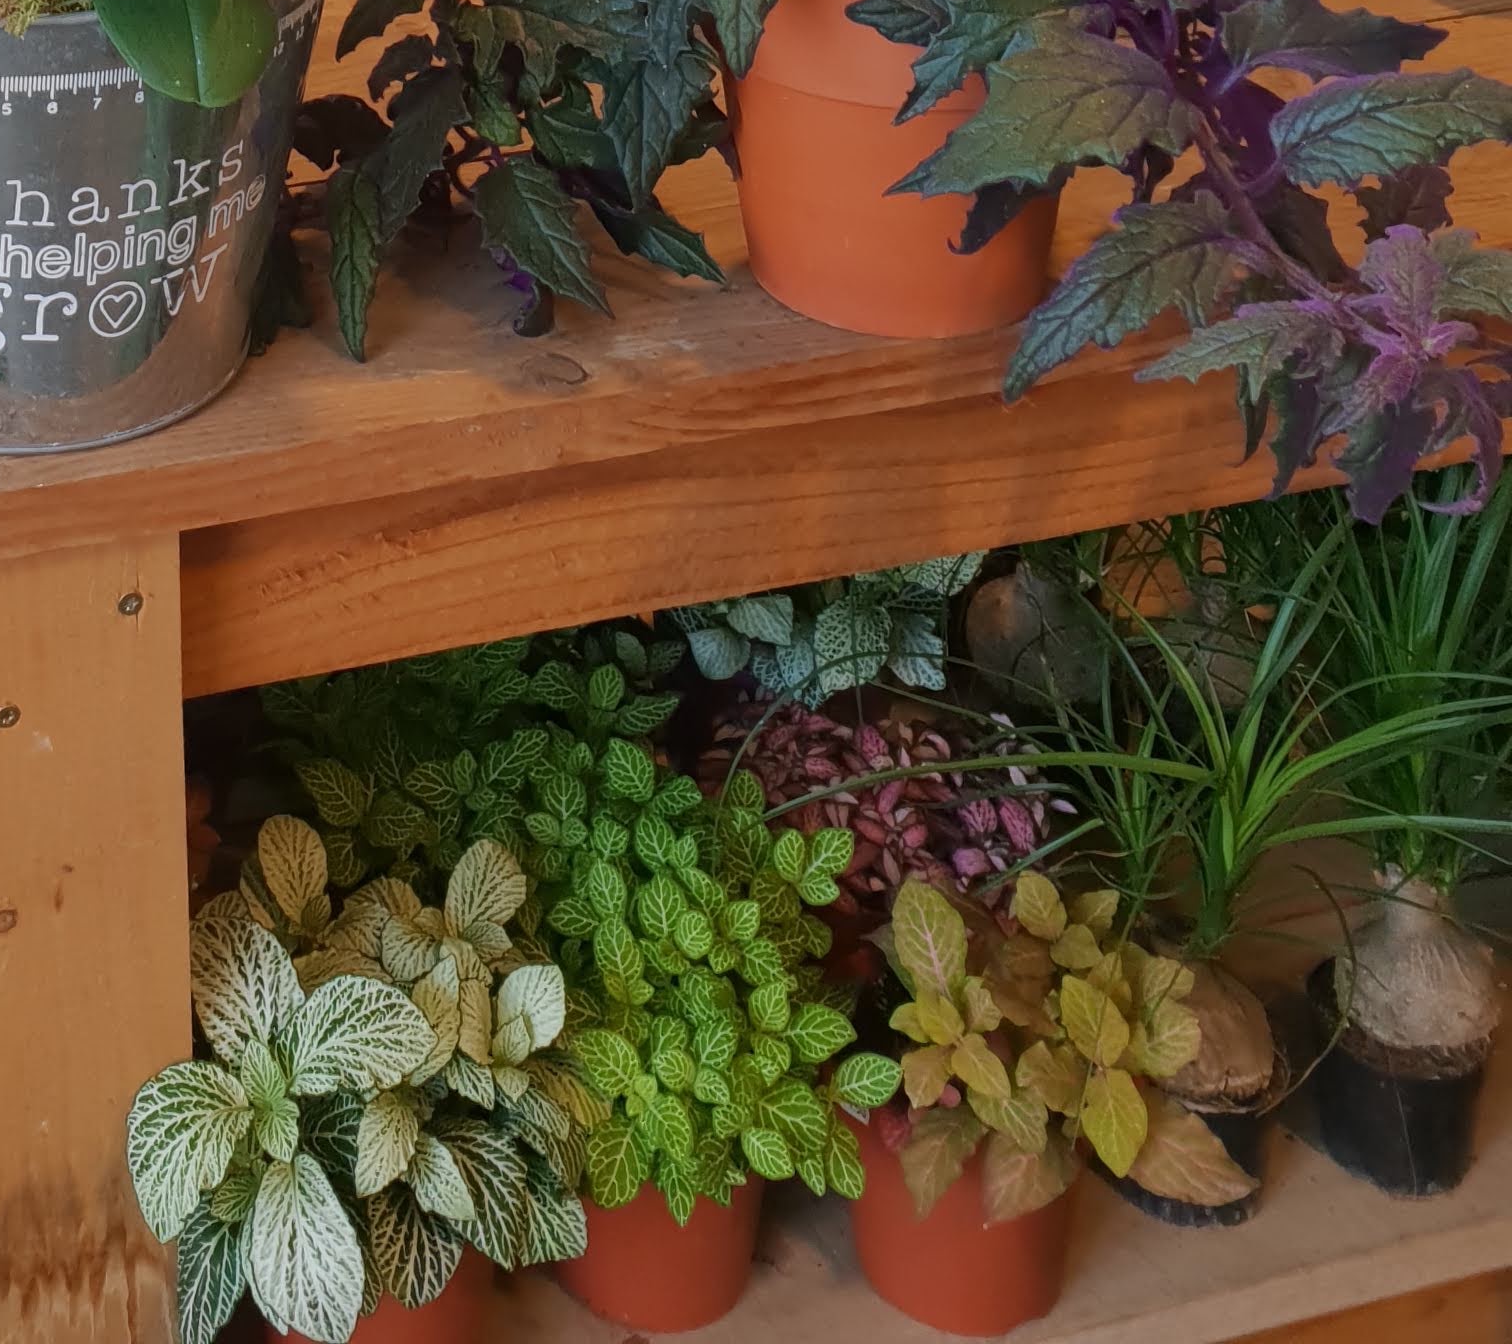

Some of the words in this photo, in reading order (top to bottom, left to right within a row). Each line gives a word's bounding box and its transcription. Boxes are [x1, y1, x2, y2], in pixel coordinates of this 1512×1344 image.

[1, 102, 13, 116] 5
[46, 102, 58, 115] 6
[92, 97, 104, 110] 7
[134, 91, 145, 104] 8
[0, 215, 198, 286] helping
[208, 173, 267, 239] me
